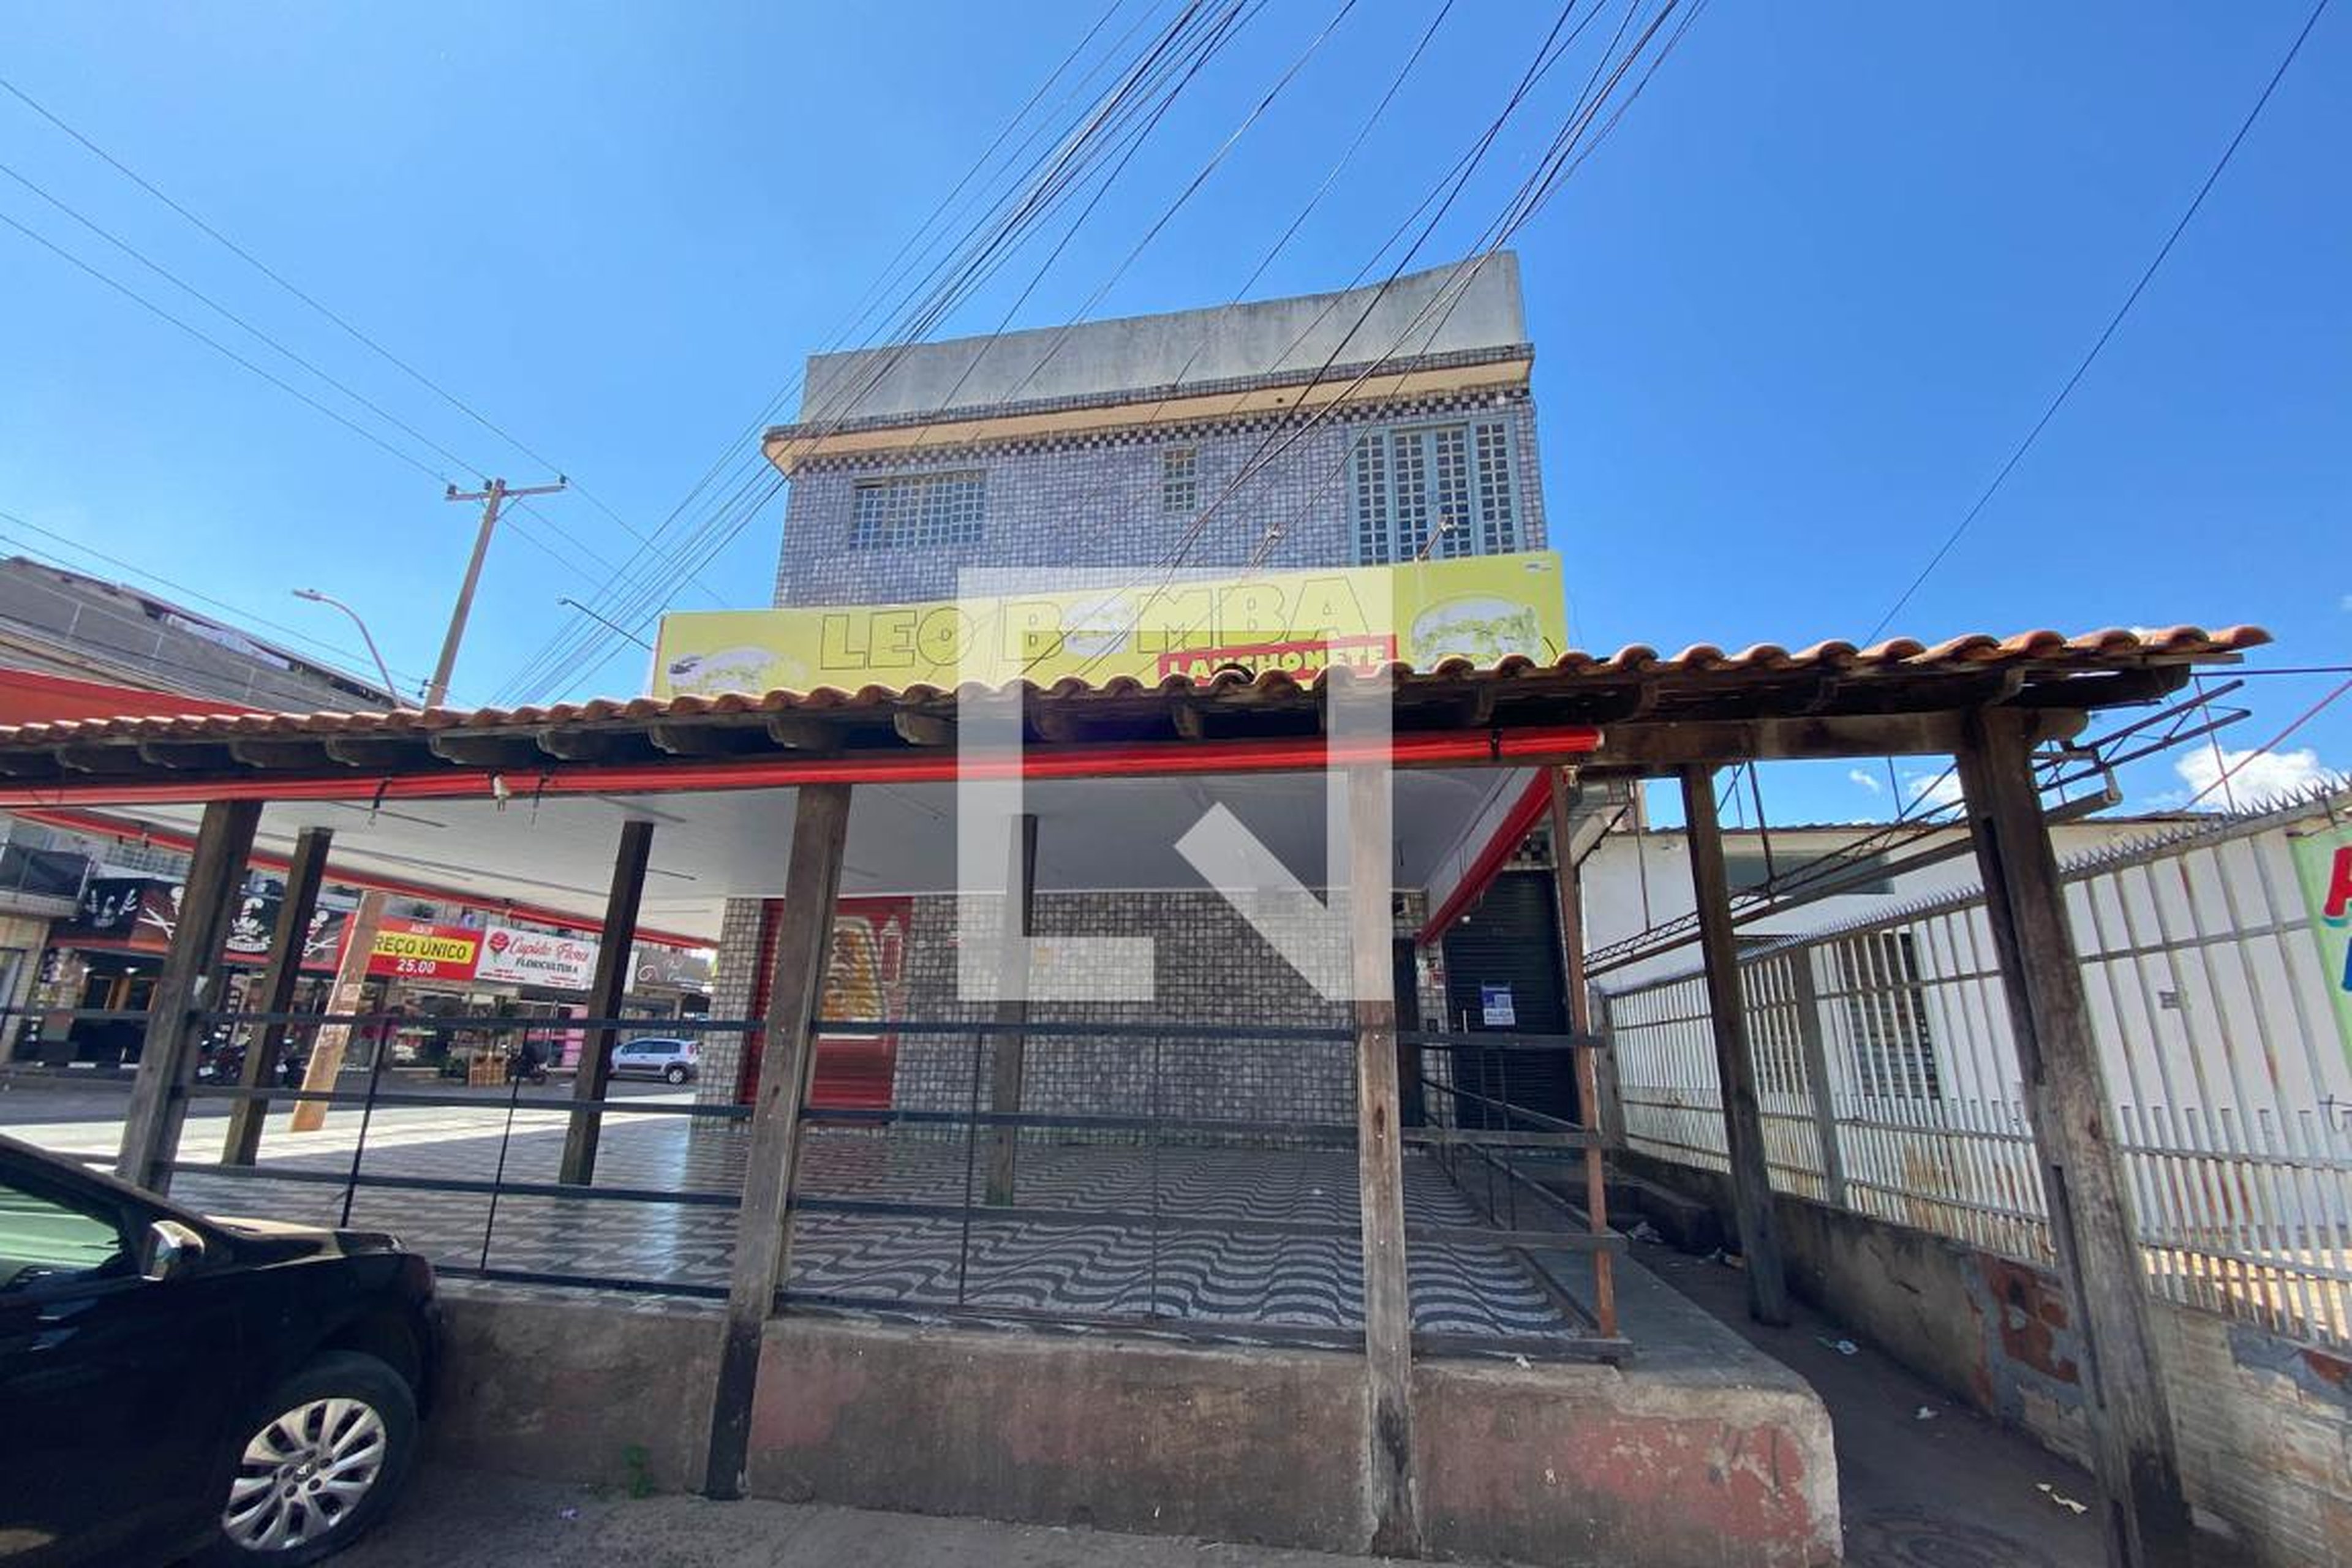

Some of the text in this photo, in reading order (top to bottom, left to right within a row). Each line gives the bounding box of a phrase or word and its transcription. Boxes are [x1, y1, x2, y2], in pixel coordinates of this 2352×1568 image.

[820, 576, 1371, 671] LEO BMBA
[375, 936, 416, 954] REÇO
[396, 959, 436, 974] 25.00
